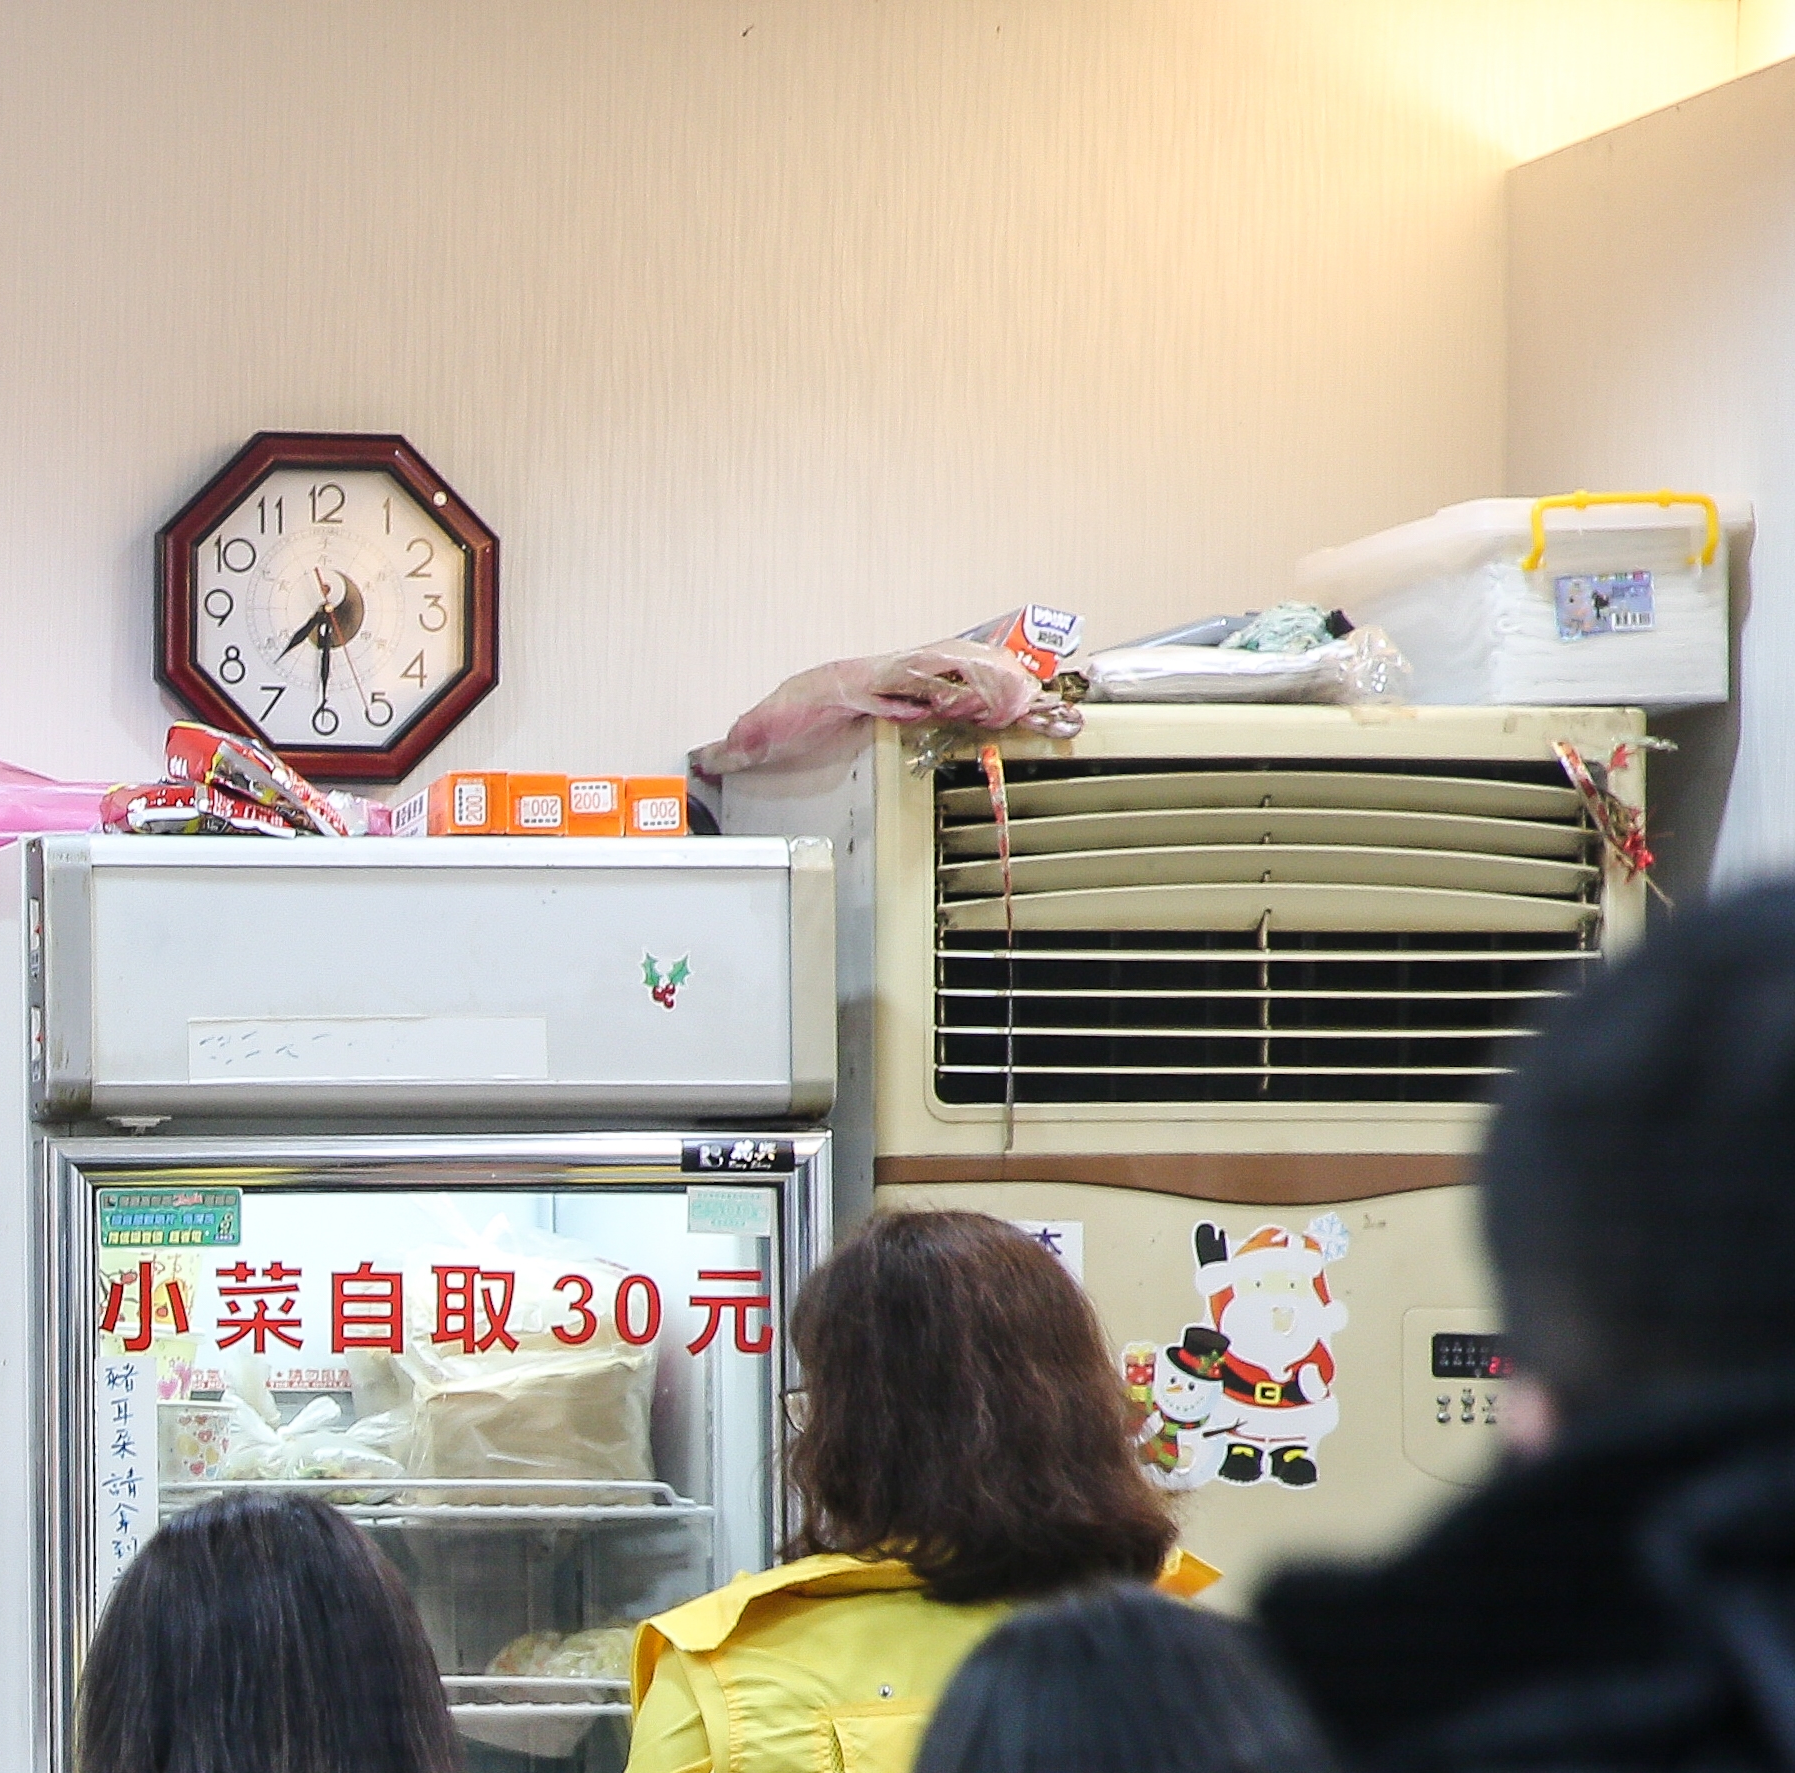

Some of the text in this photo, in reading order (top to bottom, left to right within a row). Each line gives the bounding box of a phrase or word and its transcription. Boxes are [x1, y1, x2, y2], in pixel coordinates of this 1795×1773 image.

[258, 496, 286, 535] 11
[308, 483, 346, 524] 12
[382, 497, 392, 535] 1
[214, 535, 257, 573] 10
[405, 538, 434, 578] 2
[204, 589, 234, 627] 9
[418, 594, 448, 632] 3
[219, 646, 246, 684] 8
[400, 650, 428, 688] 4
[259, 686, 286, 722] 7
[311, 698, 339, 736] 6
[364, 692, 394, 727] 5
[99, 1260, 775, 1357] 小菜自取30元
